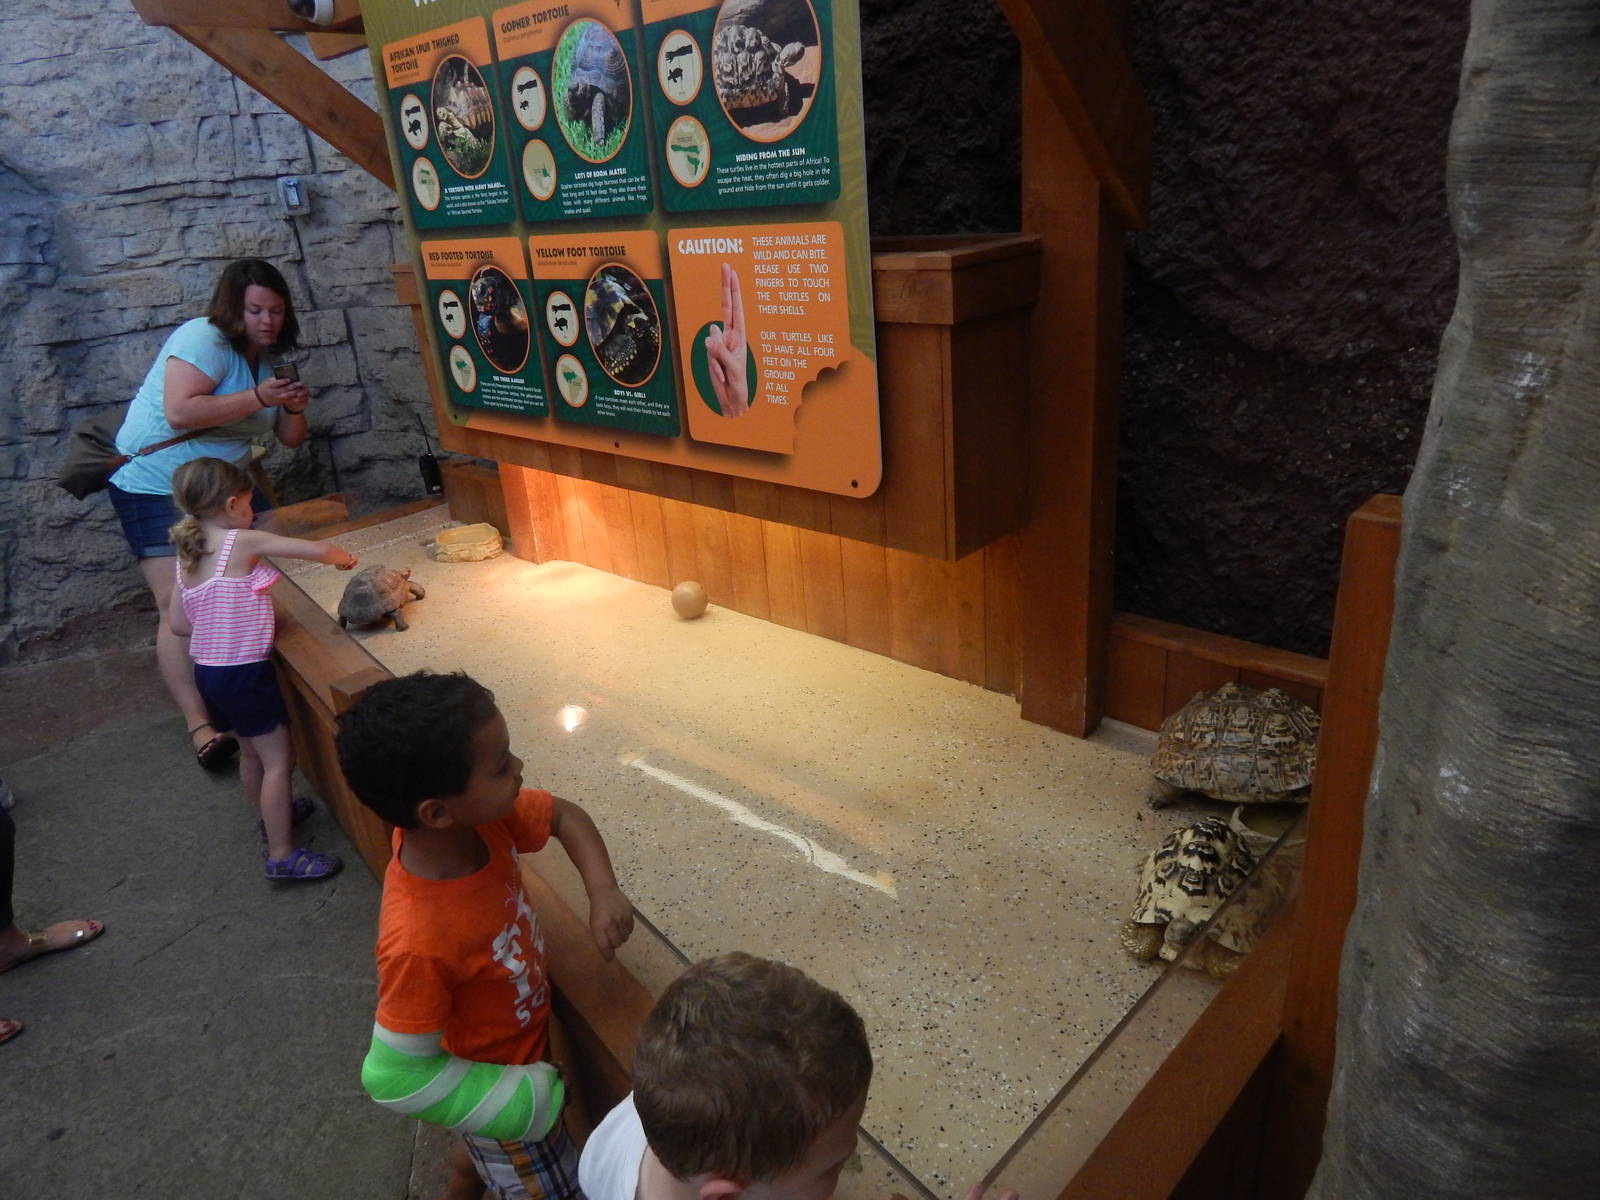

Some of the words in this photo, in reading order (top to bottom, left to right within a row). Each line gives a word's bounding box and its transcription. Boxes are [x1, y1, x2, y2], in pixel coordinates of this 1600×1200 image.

[502, 16, 530, 33] GOPHER
[532, 4, 569, 25] TORTOISE
[390, 48, 415, 62] AFRICAN
[416, 42, 431, 54] SPUR
[432, 33, 460, 50] THIGHED
[392, 59, 418, 74] TORTOISE
[736, 152, 758, 162] HIDING
[760, 150, 777, 159] FROM
[678, 238, 744, 254] CAUTION:
[752, 236, 773, 246] THESE
[775, 235, 809, 246] ANIMALS
[812, 234, 826, 245] ARE
[429, 252, 440, 260] RED
[440, 252, 464, 260] FOOTED
[465, 250, 493, 260] TORTOISE
[536, 248, 564, 258] YELLOW
[567, 247, 586, 257] FOOT
[589, 246, 626, 256] TORTOISE
[753, 250, 771, 260] WILD
[773, 250, 790, 259] AND
[791, 250, 808, 259] CAN
[810, 250, 827, 259] BITE.
[754, 264, 779, 274] PLEASE
[788, 264, 801, 274] USE
[809, 264, 828, 273] TWO
[756, 278, 784, 287] FINGERS
[788, 278, 798, 287] TO
[802, 278, 829, 287] TOUCH
[757, 292, 770, 301] THE
[778, 292, 809, 302] TURTLES
[818, 292, 830, 302] ON
[758, 305, 777, 314] THEIR
[779, 306, 805, 315] SHELLS.
[761, 330, 776, 340] OUR
[781, 332, 812, 342] TURTLES
[818, 334, 833, 343] LIKE
[762, 344, 771, 352] TO
[775, 346, 794, 354] HAVE
[797, 347, 810, 355] ALL
[814, 347, 834, 357] FOUR
[763, 356, 778, 365] FEET
[780, 358, 791, 367] ON
[793, 359, 807, 368] THE
[764, 370, 795, 380] GROUND
[776, 383, 788, 392] ALL
[766, 394, 789, 405] TIMES.
